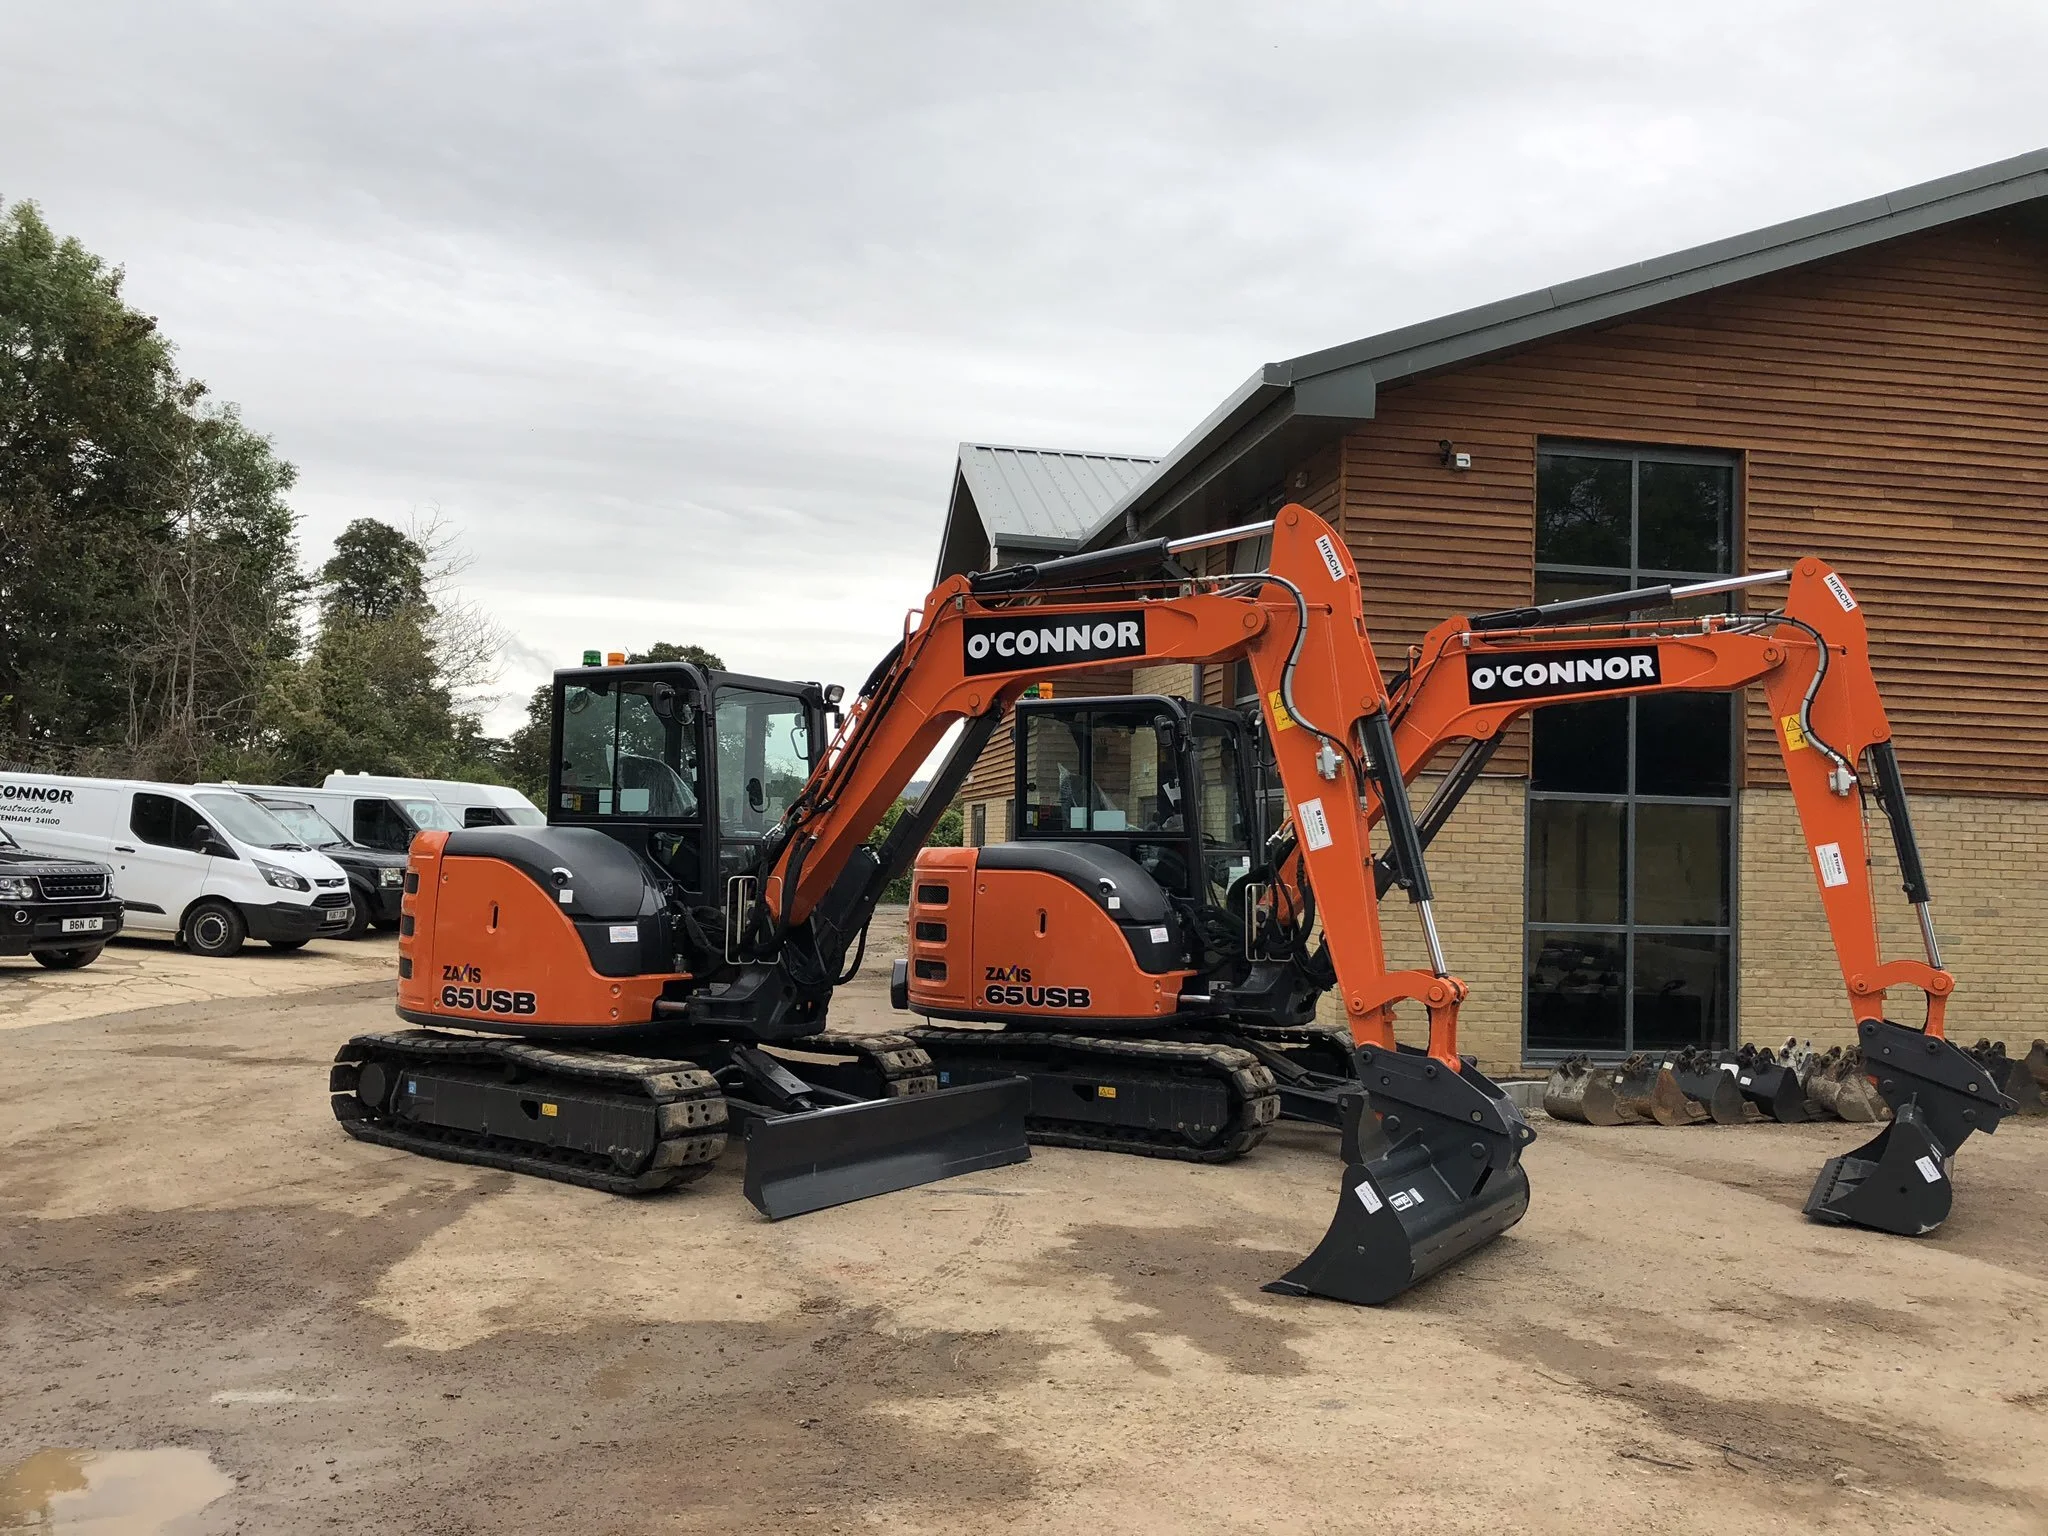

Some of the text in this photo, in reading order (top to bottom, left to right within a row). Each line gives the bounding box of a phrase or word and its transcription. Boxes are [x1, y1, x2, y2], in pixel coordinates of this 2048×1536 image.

[1320, 539, 1342, 577] HITACHI
[1828, 576, 1853, 609] HITACHI
[967, 621, 1141, 659] O'CONNOR
[1471, 655, 1655, 690] O'CONNOR
[0, 785, 74, 804] ONNOR
[0, 804, 53, 814] nstruction
[0, 814, 60, 825] ENHAM 241100
[442, 964, 482, 983] ZAXIS
[985, 965, 1031, 982] ZAXIS
[441, 985, 537, 1015] 65USB
[985, 984, 1091, 1008] 65USB
